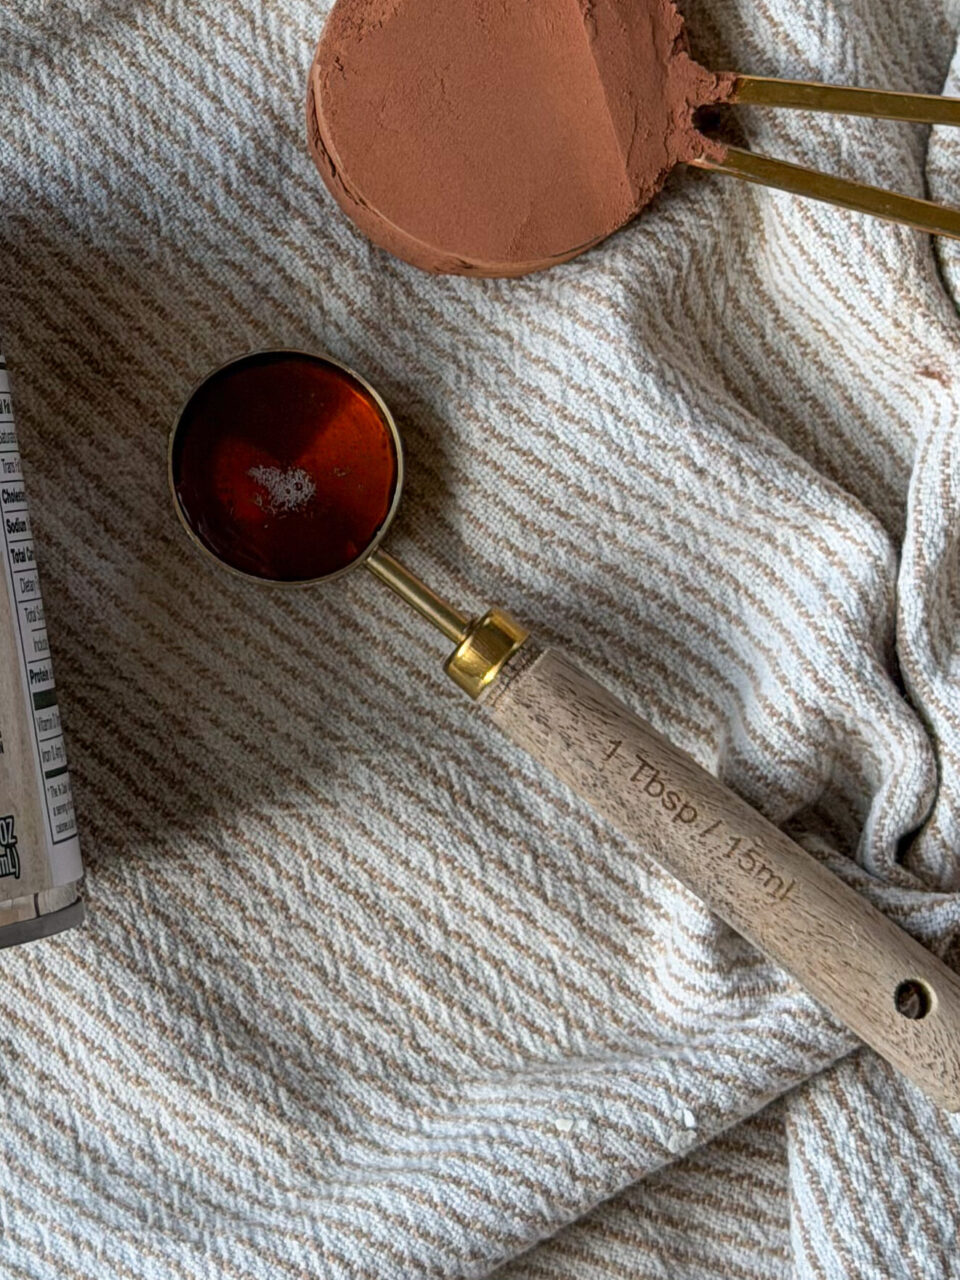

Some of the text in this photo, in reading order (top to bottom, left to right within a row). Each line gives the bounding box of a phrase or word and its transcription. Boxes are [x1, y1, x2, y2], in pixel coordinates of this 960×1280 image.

[604, 739, 623, 762] 1
[629, 753, 698, 824] Tbsp
[723, 835, 796, 902] 15ml
